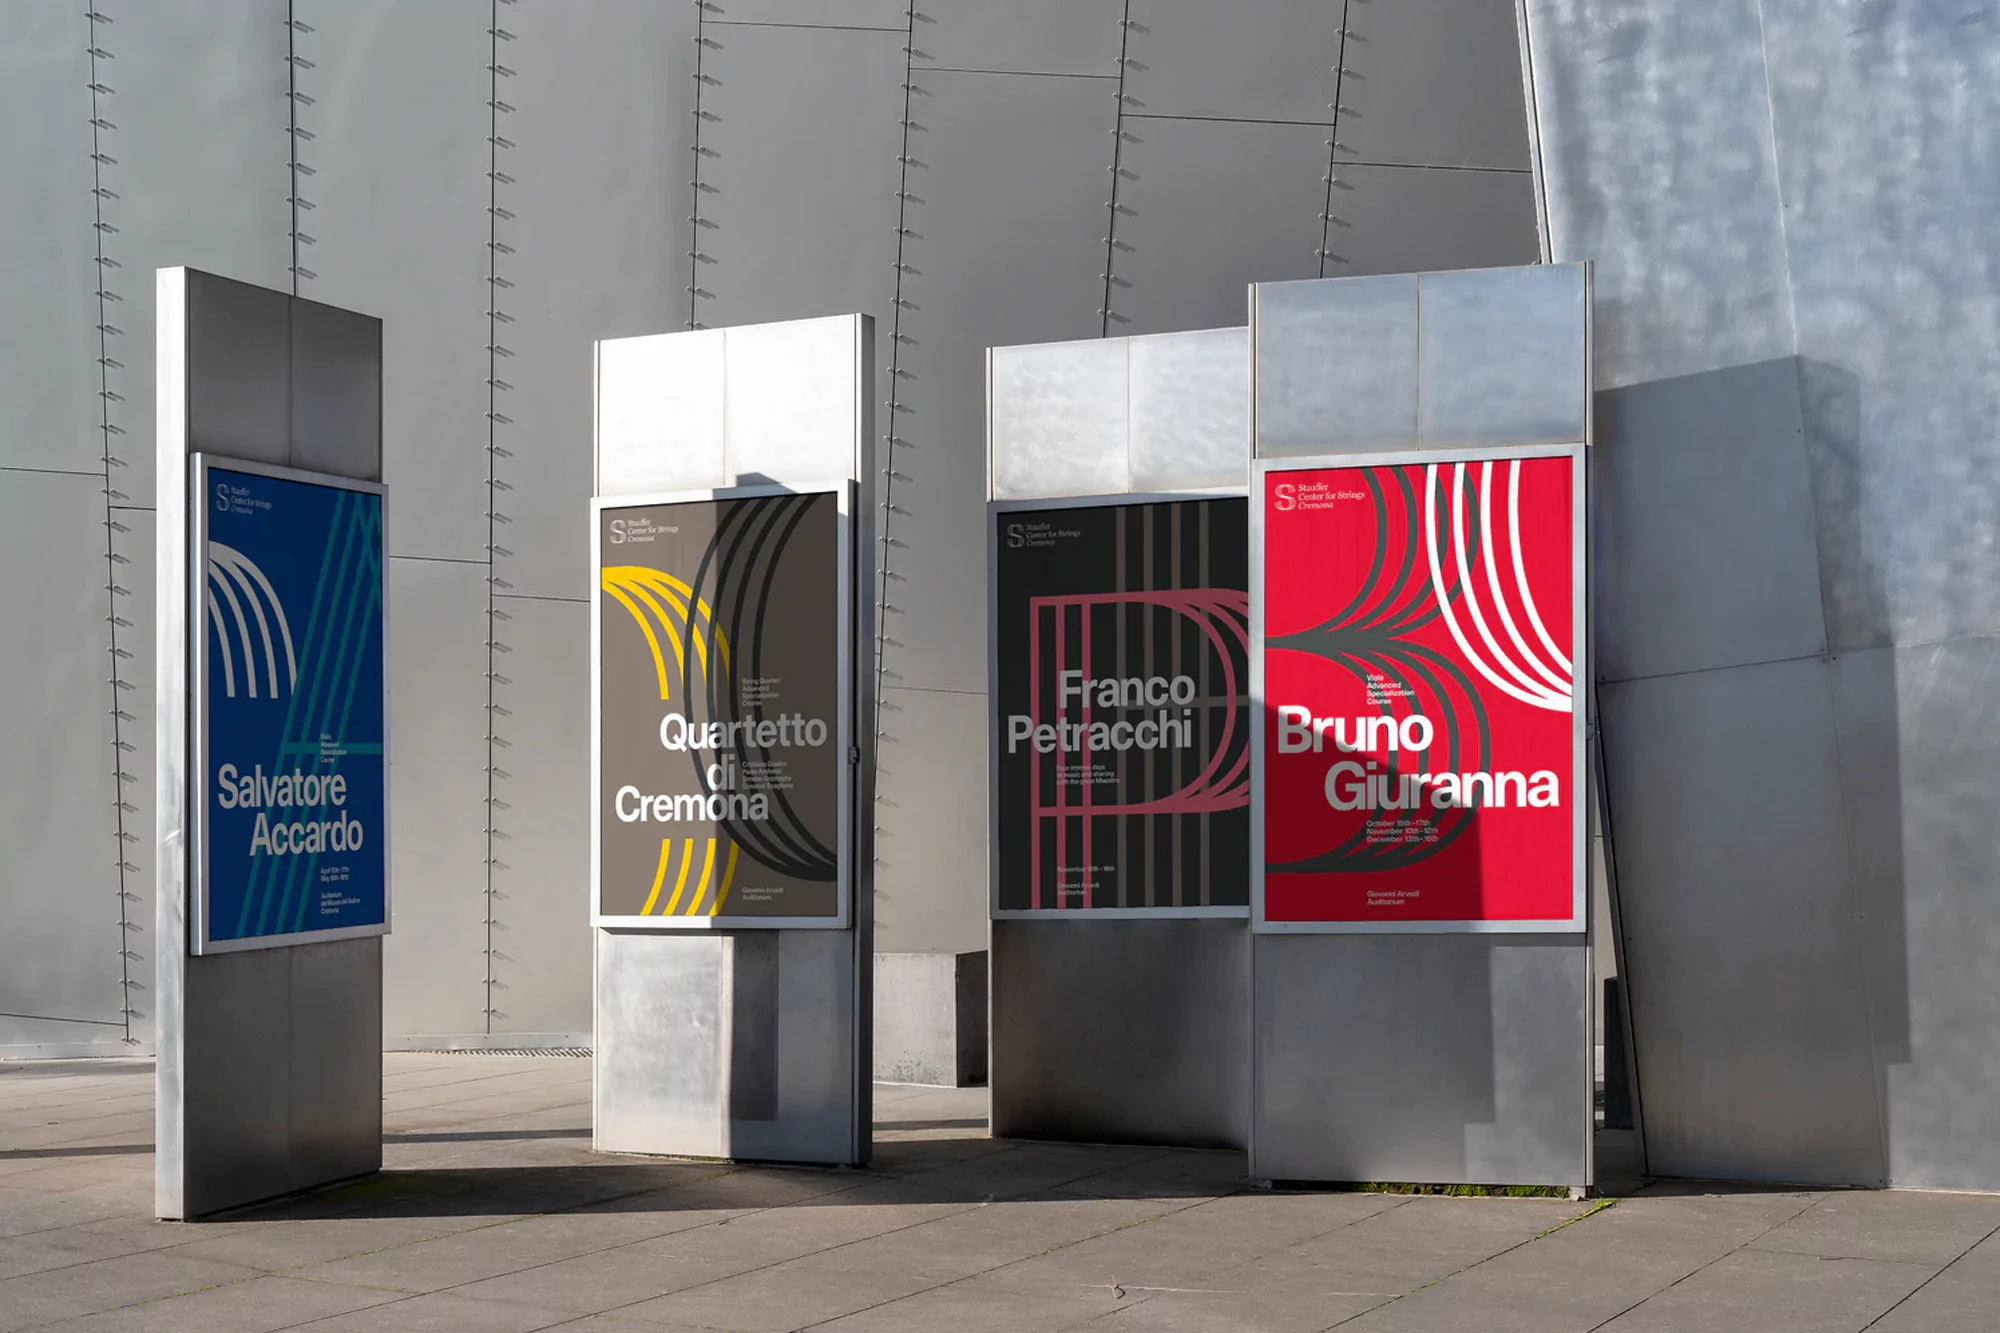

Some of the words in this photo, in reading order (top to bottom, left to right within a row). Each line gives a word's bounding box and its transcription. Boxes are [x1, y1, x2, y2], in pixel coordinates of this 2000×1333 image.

[1298, 482, 1328, 492] Stauffer
[1298, 493, 1324, 501] Center
[1326, 491, 1336, 500] for
[1338, 490, 1364, 502] Strings
[1060, 670, 1196, 709] Franco
[1367, 690, 1414, 698] Specialization
[660, 712, 827, 752] Quartetto
[1008, 708, 1192, 754] Petracchi
[1278, 705, 1434, 753] Bruno
[218, 763, 347, 809] Salvatore
[706, 754, 735, 791] di
[1324, 761, 1560, 810] Giuranna
[615, 785, 768, 822] Cremona
[250, 810, 364, 856] Accardo
